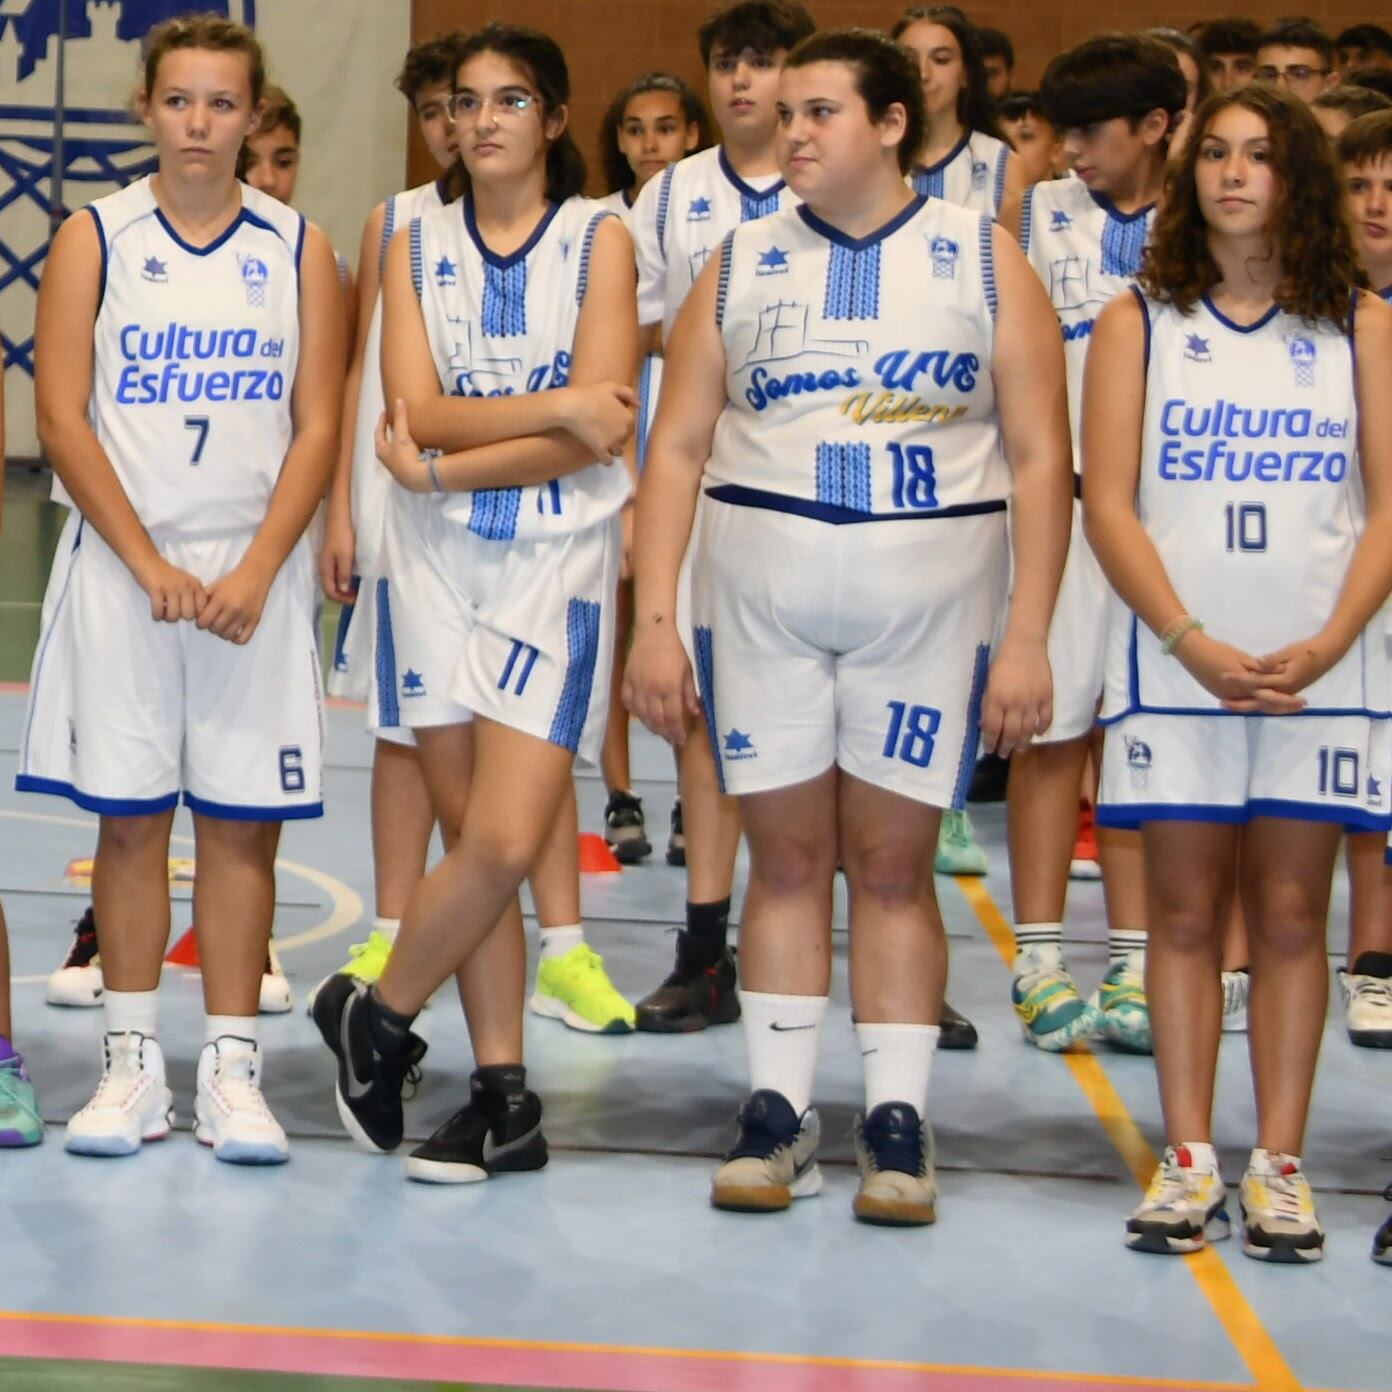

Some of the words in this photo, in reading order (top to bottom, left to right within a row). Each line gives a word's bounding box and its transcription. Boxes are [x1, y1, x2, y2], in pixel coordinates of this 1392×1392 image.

[119, 322, 257, 361] Cultura
[260, 338, 285, 359] del
[115, 362, 285, 405] Esfuerzo
[745, 365, 860, 412] Somos
[873, 349, 980, 393] UVE
[183, 414, 211, 467] 7
[1159, 398, 1313, 438] Cultura
[1315, 417, 1349, 439] del
[885, 440, 939, 509] 18
[1157, 439, 1348, 484] Esfuerzo
[1222, 500, 1267, 553] 10
[496, 636, 541, 697] 11
[882, 699, 942, 769] 18
[278, 744, 306, 794] 6
[1316, 744, 1360, 798] 10
